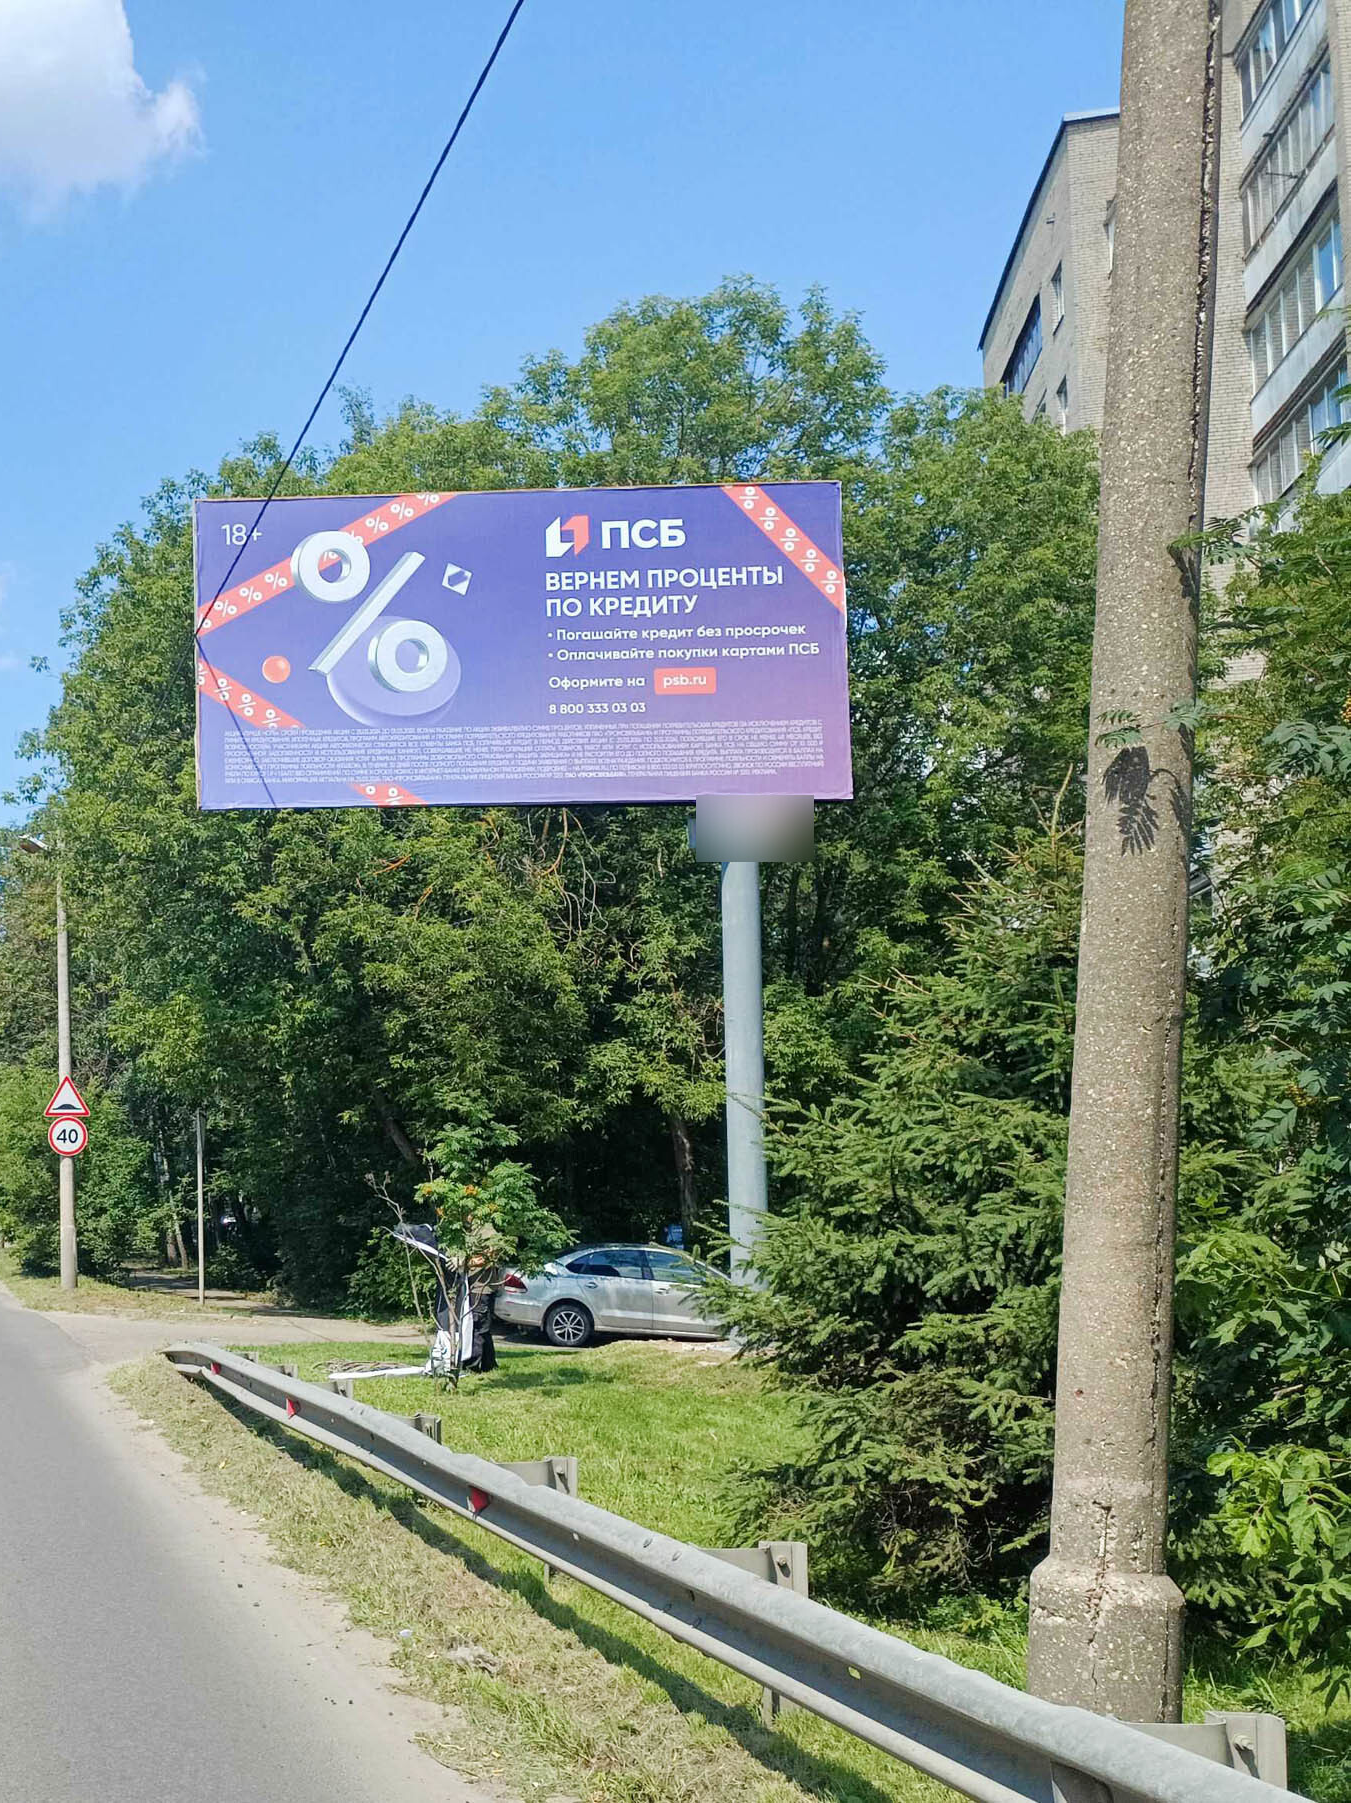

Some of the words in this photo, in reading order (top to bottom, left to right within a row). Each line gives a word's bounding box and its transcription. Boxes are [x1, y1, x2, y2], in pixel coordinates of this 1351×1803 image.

[221, 523, 262, 546] 18+
[601, 519, 686, 549] ПСБ
[545, 570, 640, 591] ВЕРНЕМ
[647, 565, 783, 589] ПРОЦЕНТЫ
[546, 598, 582, 617] ПО
[589, 594, 699, 618] КРЕДИТУ
[556, 628, 638, 641] Погашайте
[642, 626, 693, 640] кредит
[697, 625, 721, 638] без
[725, 624, 806, 639] просрочек
[557, 647, 654, 661] Оплачивайте
[658, 649, 719, 662] покупки
[722, 646, 785, 660] картами
[788, 643, 820, 655] ПСБ
[548, 676, 623, 691] Оформите
[627, 677, 646, 687] на
[662, 674, 707, 688] psb.ru
[548, 704, 557, 714] 8
[560, 703, 584, 714] 800
[587, 702, 609, 713] 333
[612, 702, 627, 713] 03
[630, 702, 646, 713] 03
[56, 1129, 78, 1143] 40
